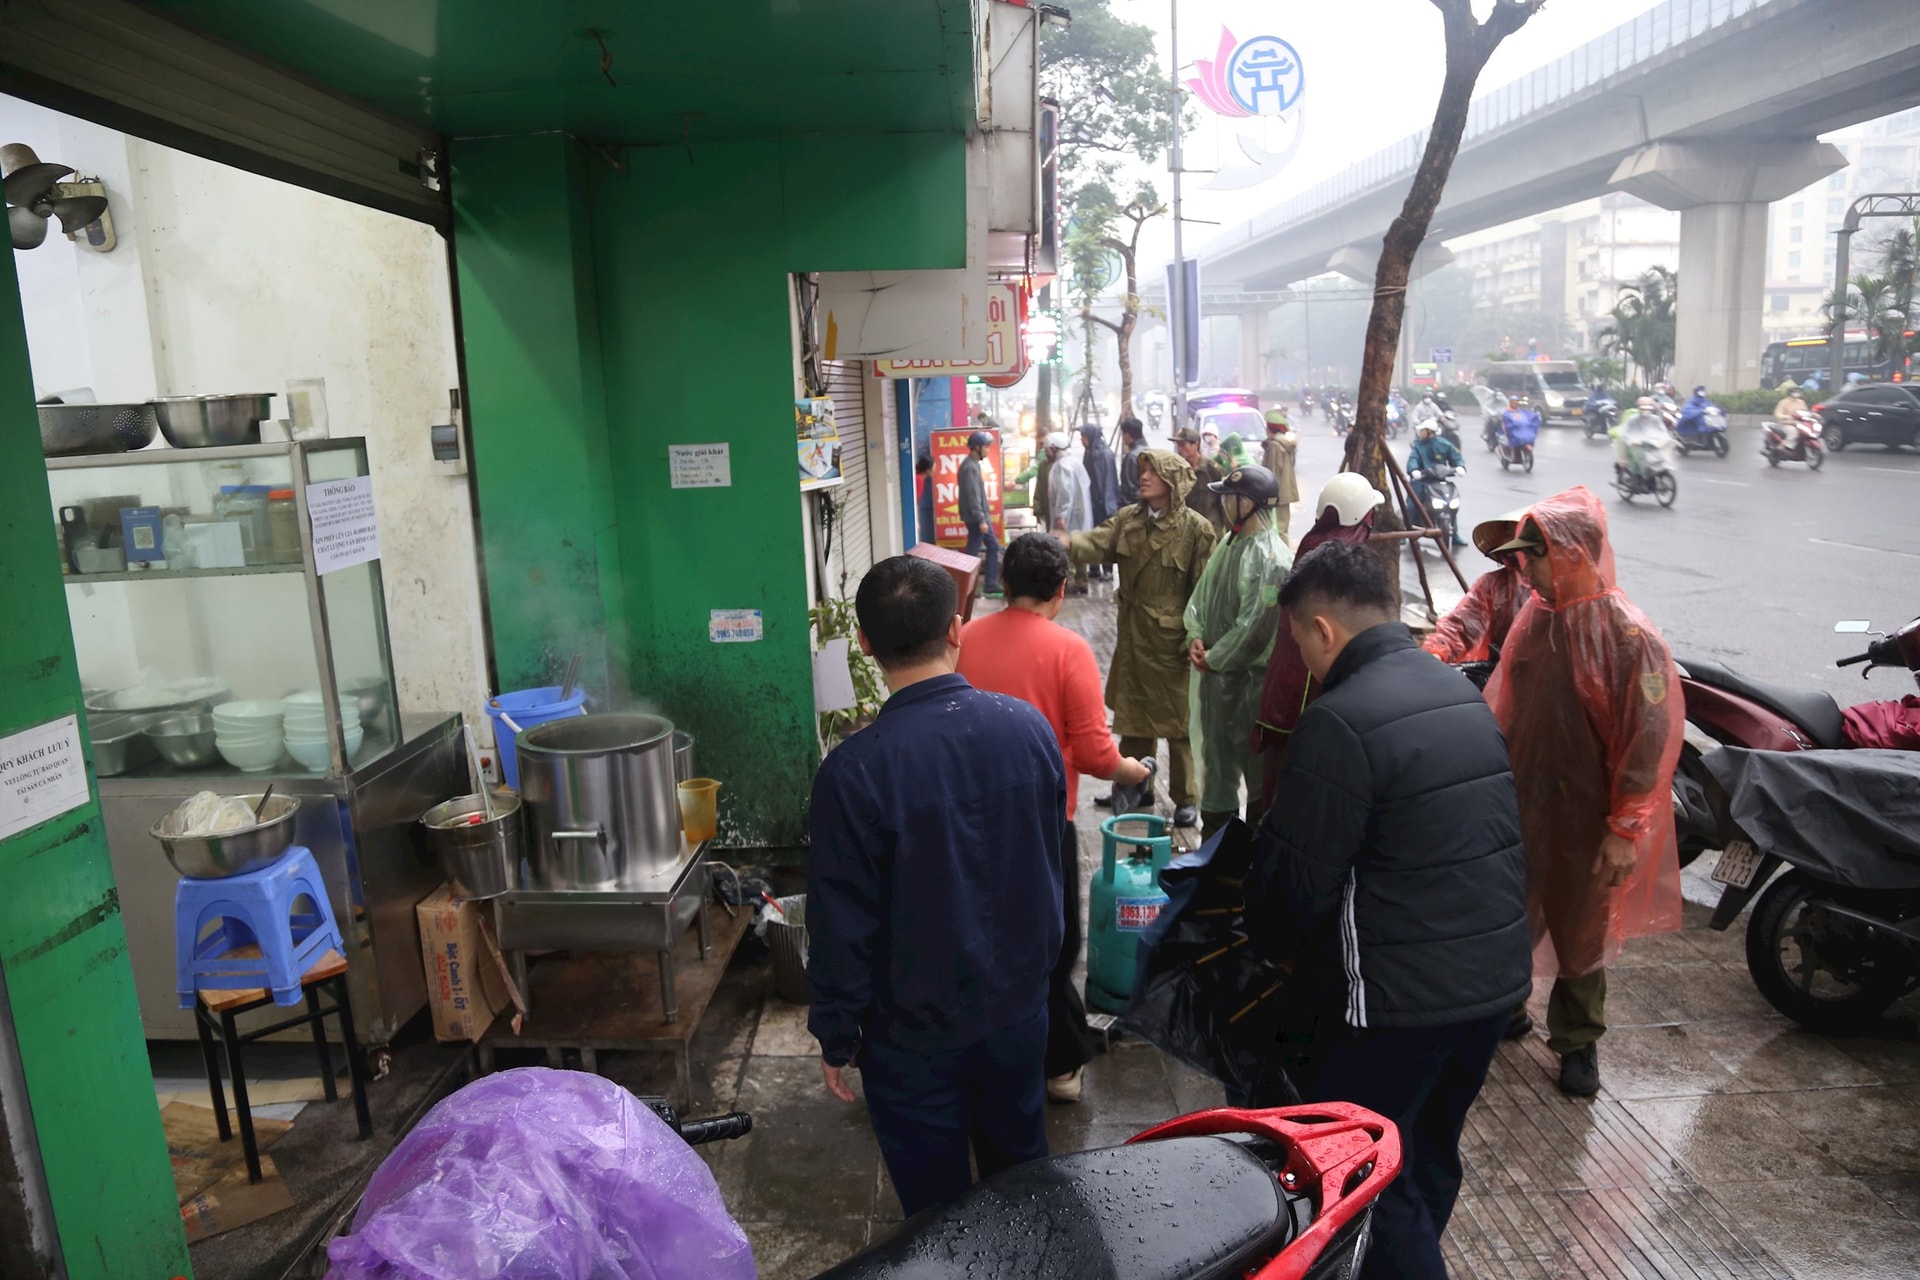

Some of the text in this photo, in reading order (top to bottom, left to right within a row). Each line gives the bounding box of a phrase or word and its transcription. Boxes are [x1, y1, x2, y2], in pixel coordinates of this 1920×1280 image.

[987, 296, 1006, 327] ỘI
[16, 748, 45, 767] KHÁCH
[48, 741, 63, 754] LƯU
